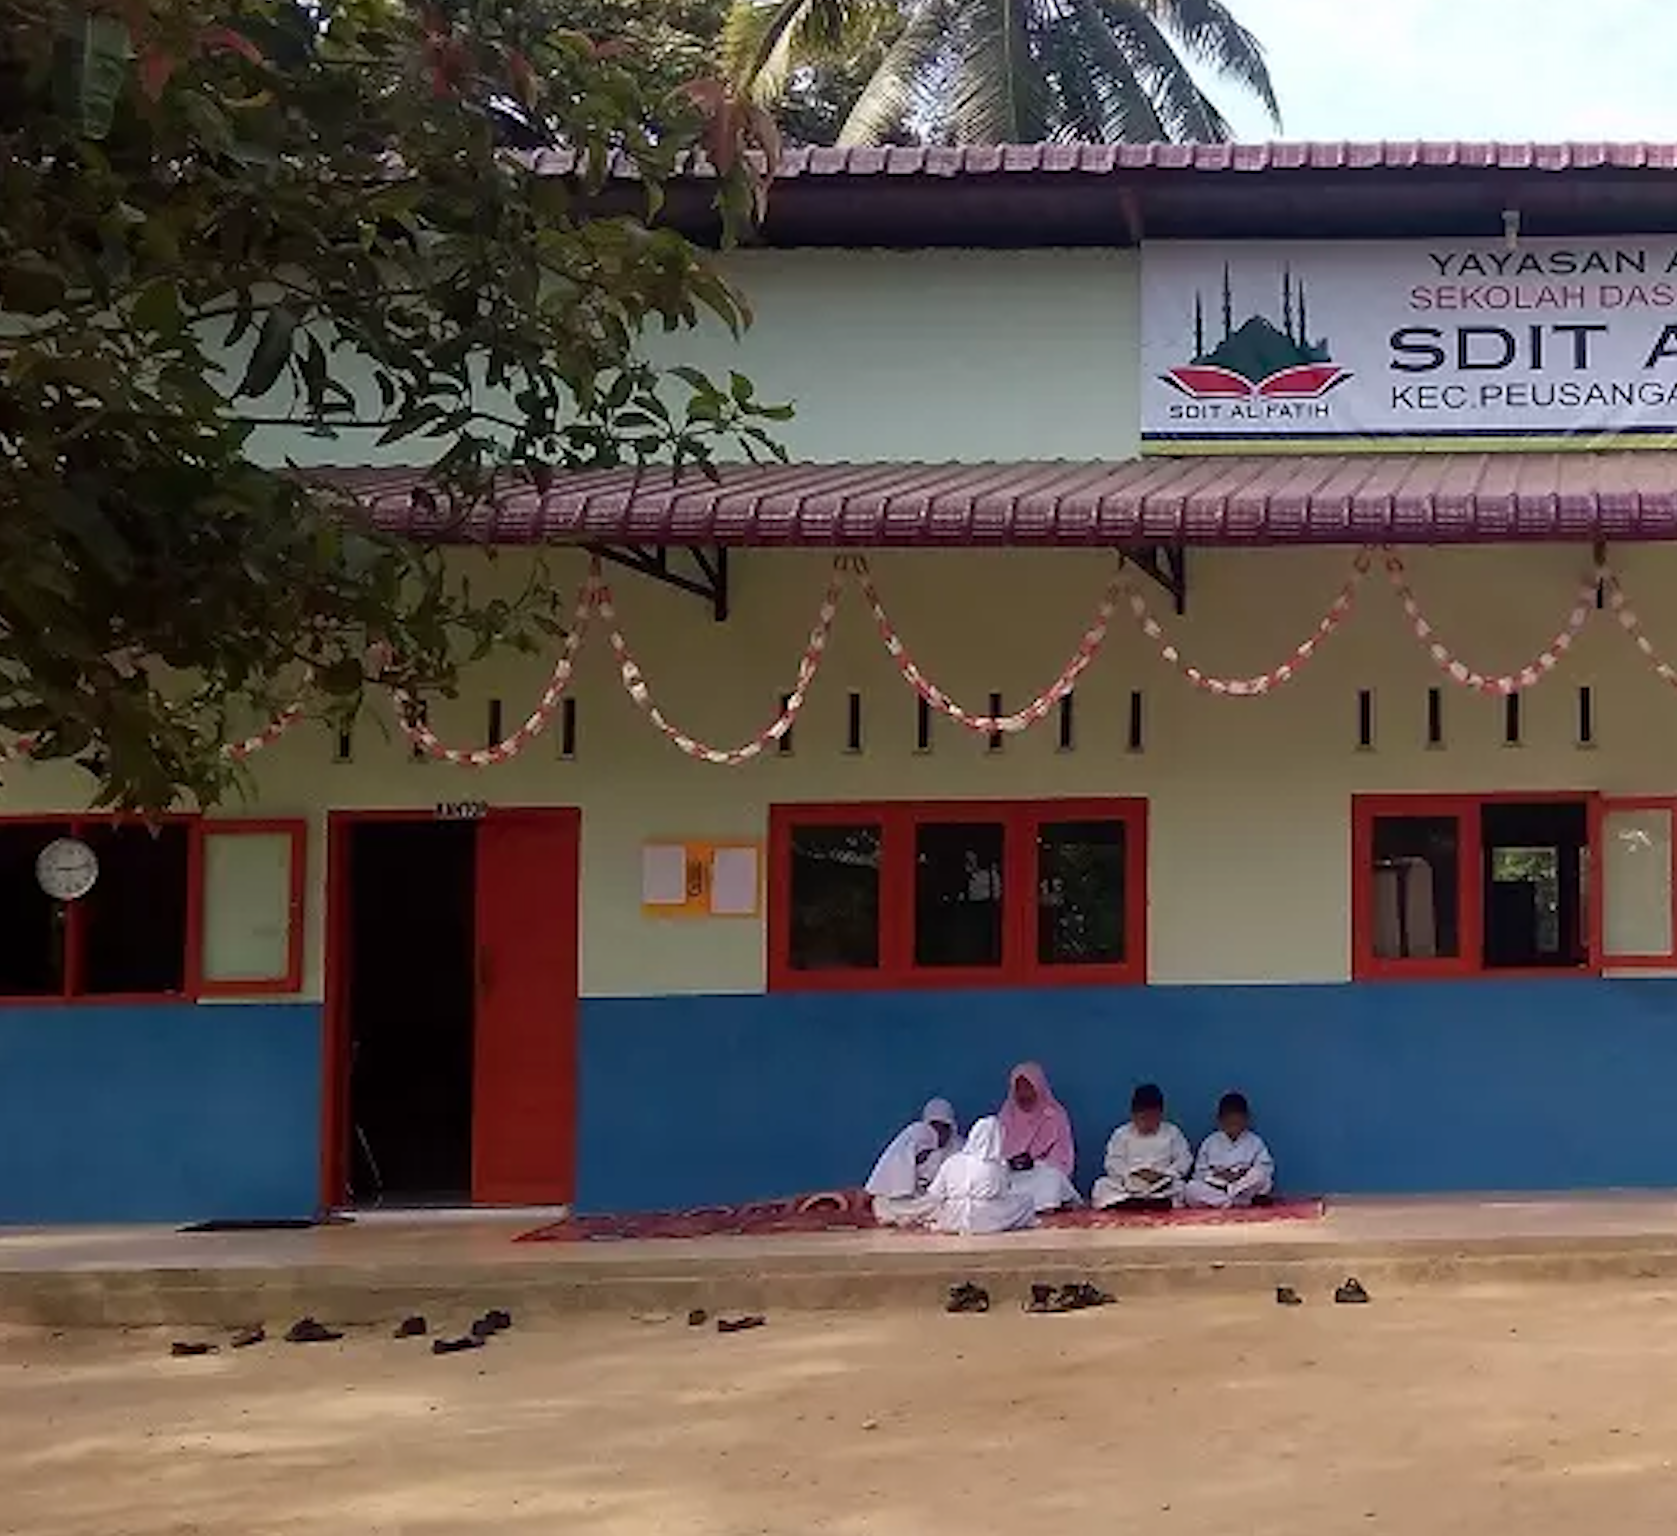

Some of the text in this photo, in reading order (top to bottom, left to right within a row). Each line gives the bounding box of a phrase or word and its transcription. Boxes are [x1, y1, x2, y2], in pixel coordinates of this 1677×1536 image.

[1429, 251, 1645, 276] YAYASAN
[1410, 285, 1585, 310] SEKOLAH
[1390, 323, 1608, 372] SDIT
[1169, 404, 1221, 419] SDIT
